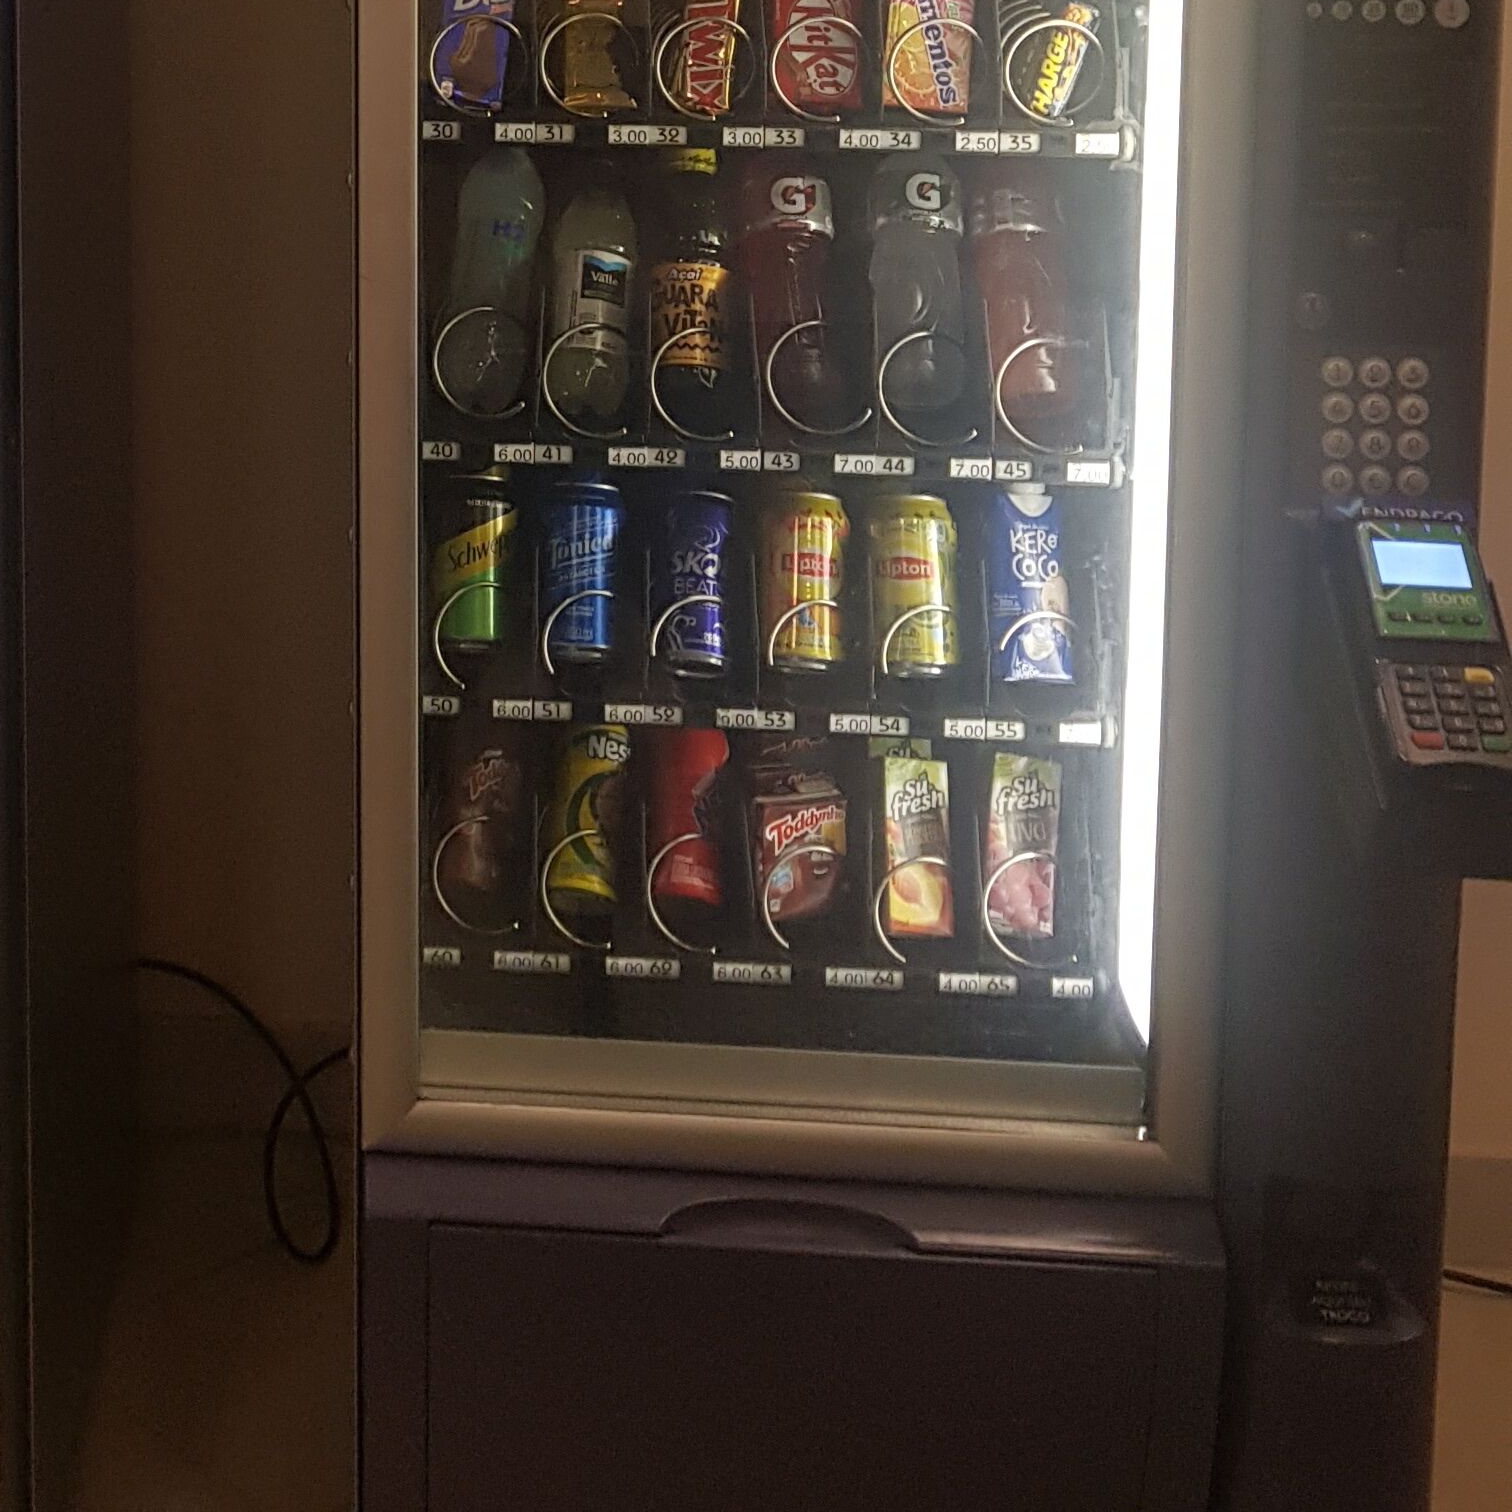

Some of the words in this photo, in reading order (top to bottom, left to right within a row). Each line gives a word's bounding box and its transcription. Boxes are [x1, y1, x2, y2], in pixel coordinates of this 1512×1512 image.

[429, 123, 454, 140] 30
[543, 125, 565, 141] 31
[655, 128, 681, 144] 32
[773, 129, 798, 145] 33
[888, 131, 914, 148] 34
[1007, 134, 1033, 151] 35
[429, 443, 454, 459] 40
[541, 445, 563, 461] 41
[653, 449, 679, 465] 42
[770, 452, 795, 468] 43
[881, 457, 906, 473] 44
[1002, 461, 1028, 478] 45
[430, 698, 454, 714] 50
[541, 703, 562, 719] 51
[651, 706, 676, 723] 52
[763, 712, 787, 728] 53
[877, 717, 902, 733] 54
[993, 721, 1017, 738] 55
[904, 778, 929, 799] su
[1013, 776, 1038, 797] su
[891, 790, 945, 822] fresh
[996, 788, 1055, 817] fresh
